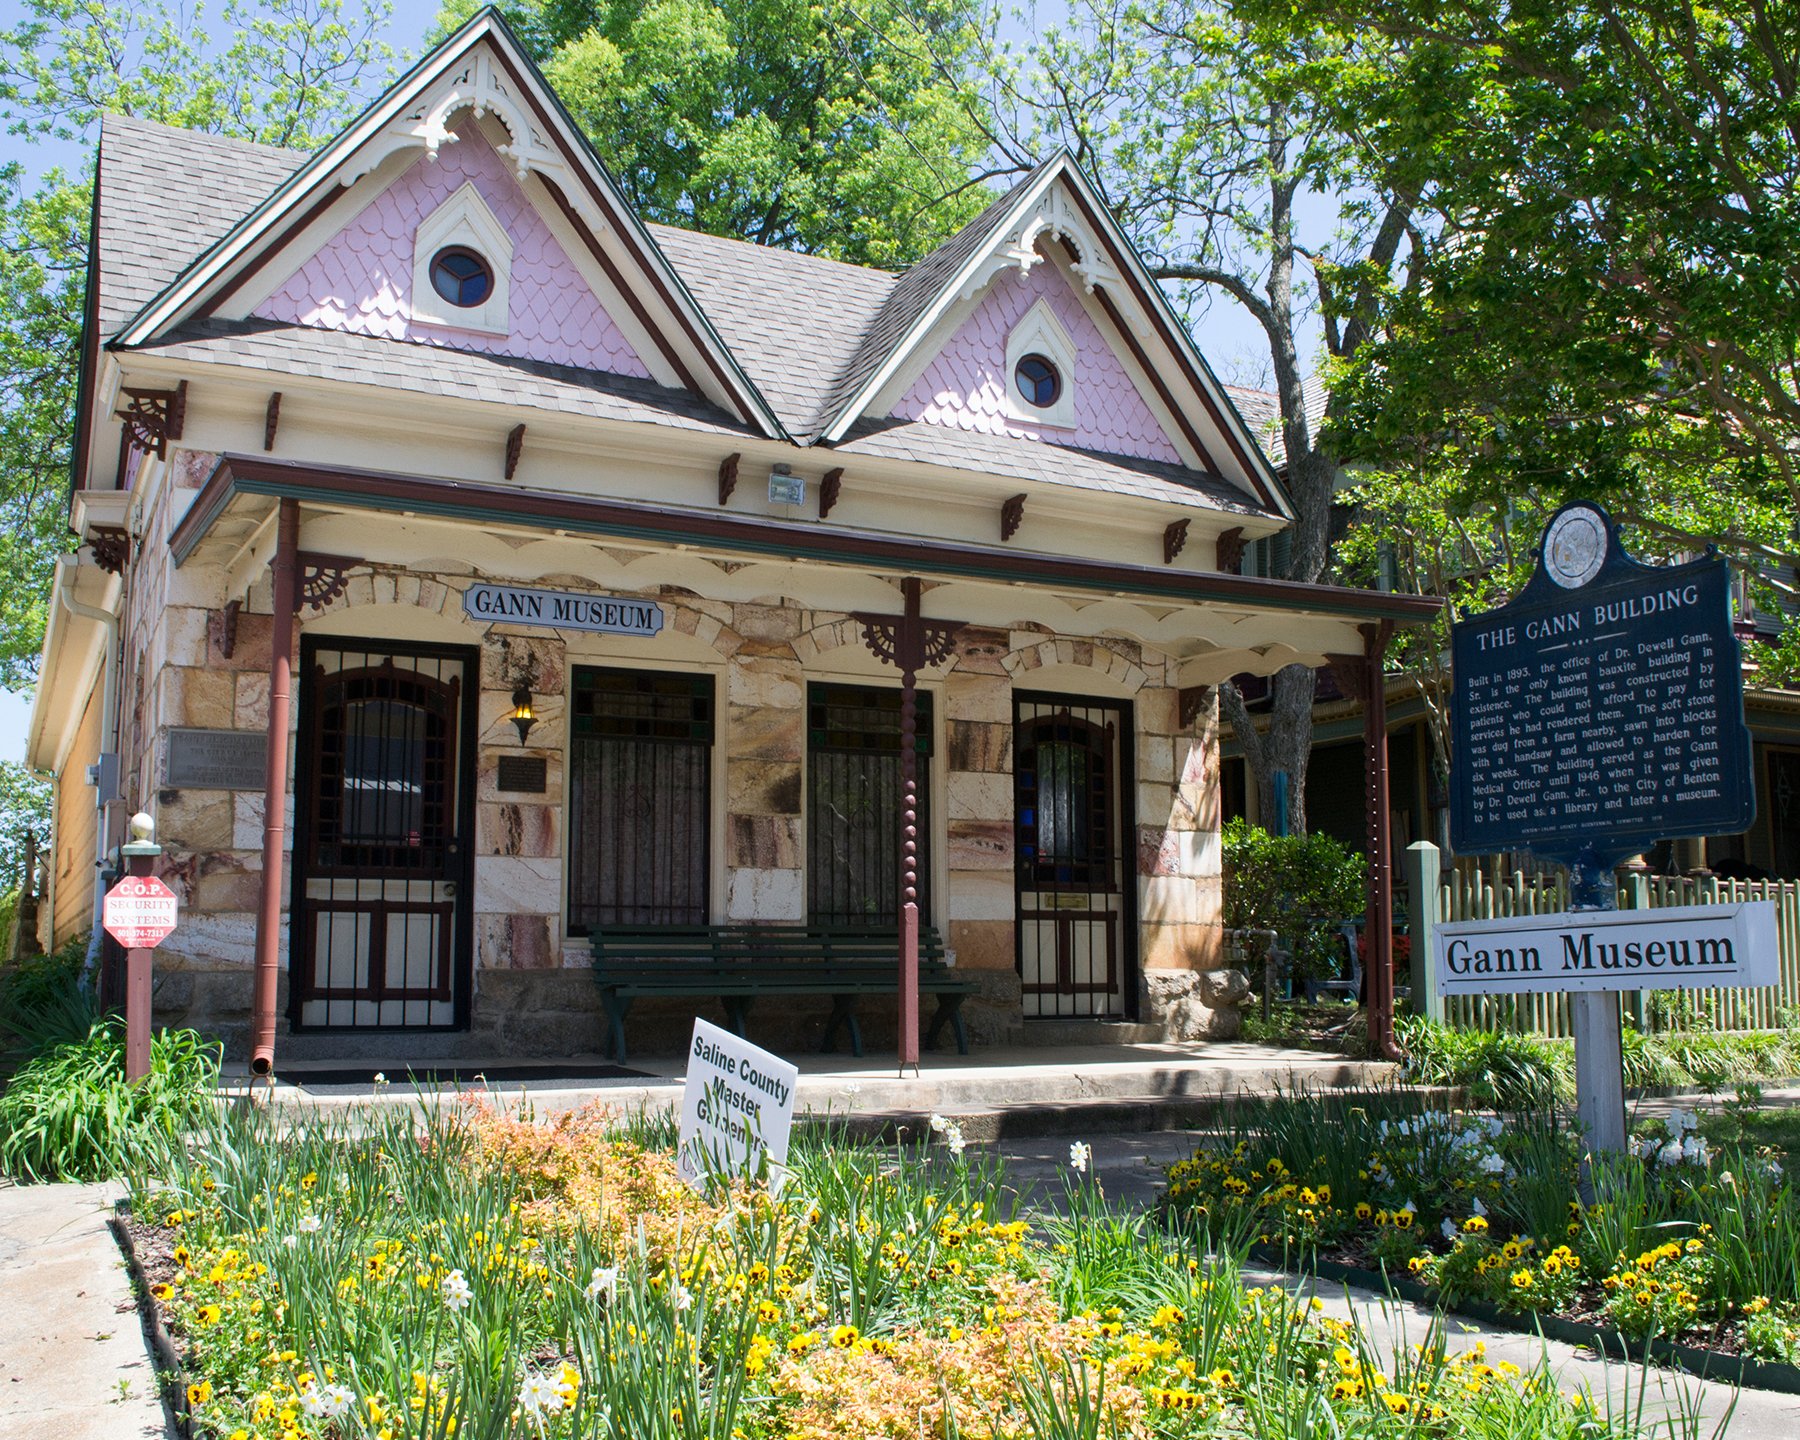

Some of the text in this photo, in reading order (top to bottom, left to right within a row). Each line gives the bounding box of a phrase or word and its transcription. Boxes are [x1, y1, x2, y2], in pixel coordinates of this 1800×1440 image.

[475, 590, 654, 630] GANN MUSEUM
[1477, 585, 1698, 651] THE GANN BUILDING
[1468, 676, 1489, 687] Built
[1494, 673, 1502, 682] in
[1541, 664, 1555, 673] the
[1562, 657, 1590, 669] office
[1598, 651, 1608, 662] of
[1615, 648, 1630, 659] Dr.
[1638, 638, 1674, 654] Dewell
[1469, 647, 1713, 701] Sr. is the only known bauxite building in
[1470, 664, 1714, 714] existence. The building was constructed by
[1470, 679, 1714, 730] patients who could not afford to pay for
[1471, 694, 1715, 741] services he had rendered them. The soft stone
[1471, 746, 1486, 754] was
[1492, 742, 1508, 752] dug
[1514, 738, 1535, 748] from
[1554, 733, 1575, 742] farm
[1624, 721, 1648, 731] sawn
[1656, 717, 1675, 727] into
[1683, 710, 1716, 722] blocks
[1472, 758, 1490, 768] with
[1515, 749, 1552, 762] handsaw
[1561, 745, 1577, 755] and
[1587, 737, 1624, 752] allowed
[1633, 737, 1643, 745] to
[1653, 729, 1690, 742] harden
[1701, 726, 1717, 735] for
[1472, 742, 1718, 782] six weeks. The building served as the Gann
[1472, 757, 1719, 795] Medical Office until 1946 when it was given
[1473, 800, 1483, 810] by
[1489, 798, 1501, 807] Dr.
[1507, 794, 1536, 805] Dewell
[1598, 785, 1608, 794] to
[1614, 782, 1629, 792] the
[1636, 779, 1658, 790] City
[1665, 776, 1676, 786] of
[1684, 773, 1720, 784] Benton
[1474, 814, 1483, 822] to
[1489, 812, 1500, 821] be
[1507, 809, 1527, 819] used
[1550, 807, 1556, 815] a
[1565, 803, 1598, 813] library
[1605, 799, 1622, 809] and
[1630, 796, 1654, 806] later
[1662, 794, 1668, 802] a
[1676, 789, 1720, 801] museum.
[110, 901, 172, 909] SECURITY
[120, 884, 163, 895] C.O.P.
[112, 916, 170, 924] SYSTEMS
[1447, 933, 1736, 974] Gann Museum
[694, 1036, 789, 1107] Saline County
[712, 1076, 761, 1119] Master
